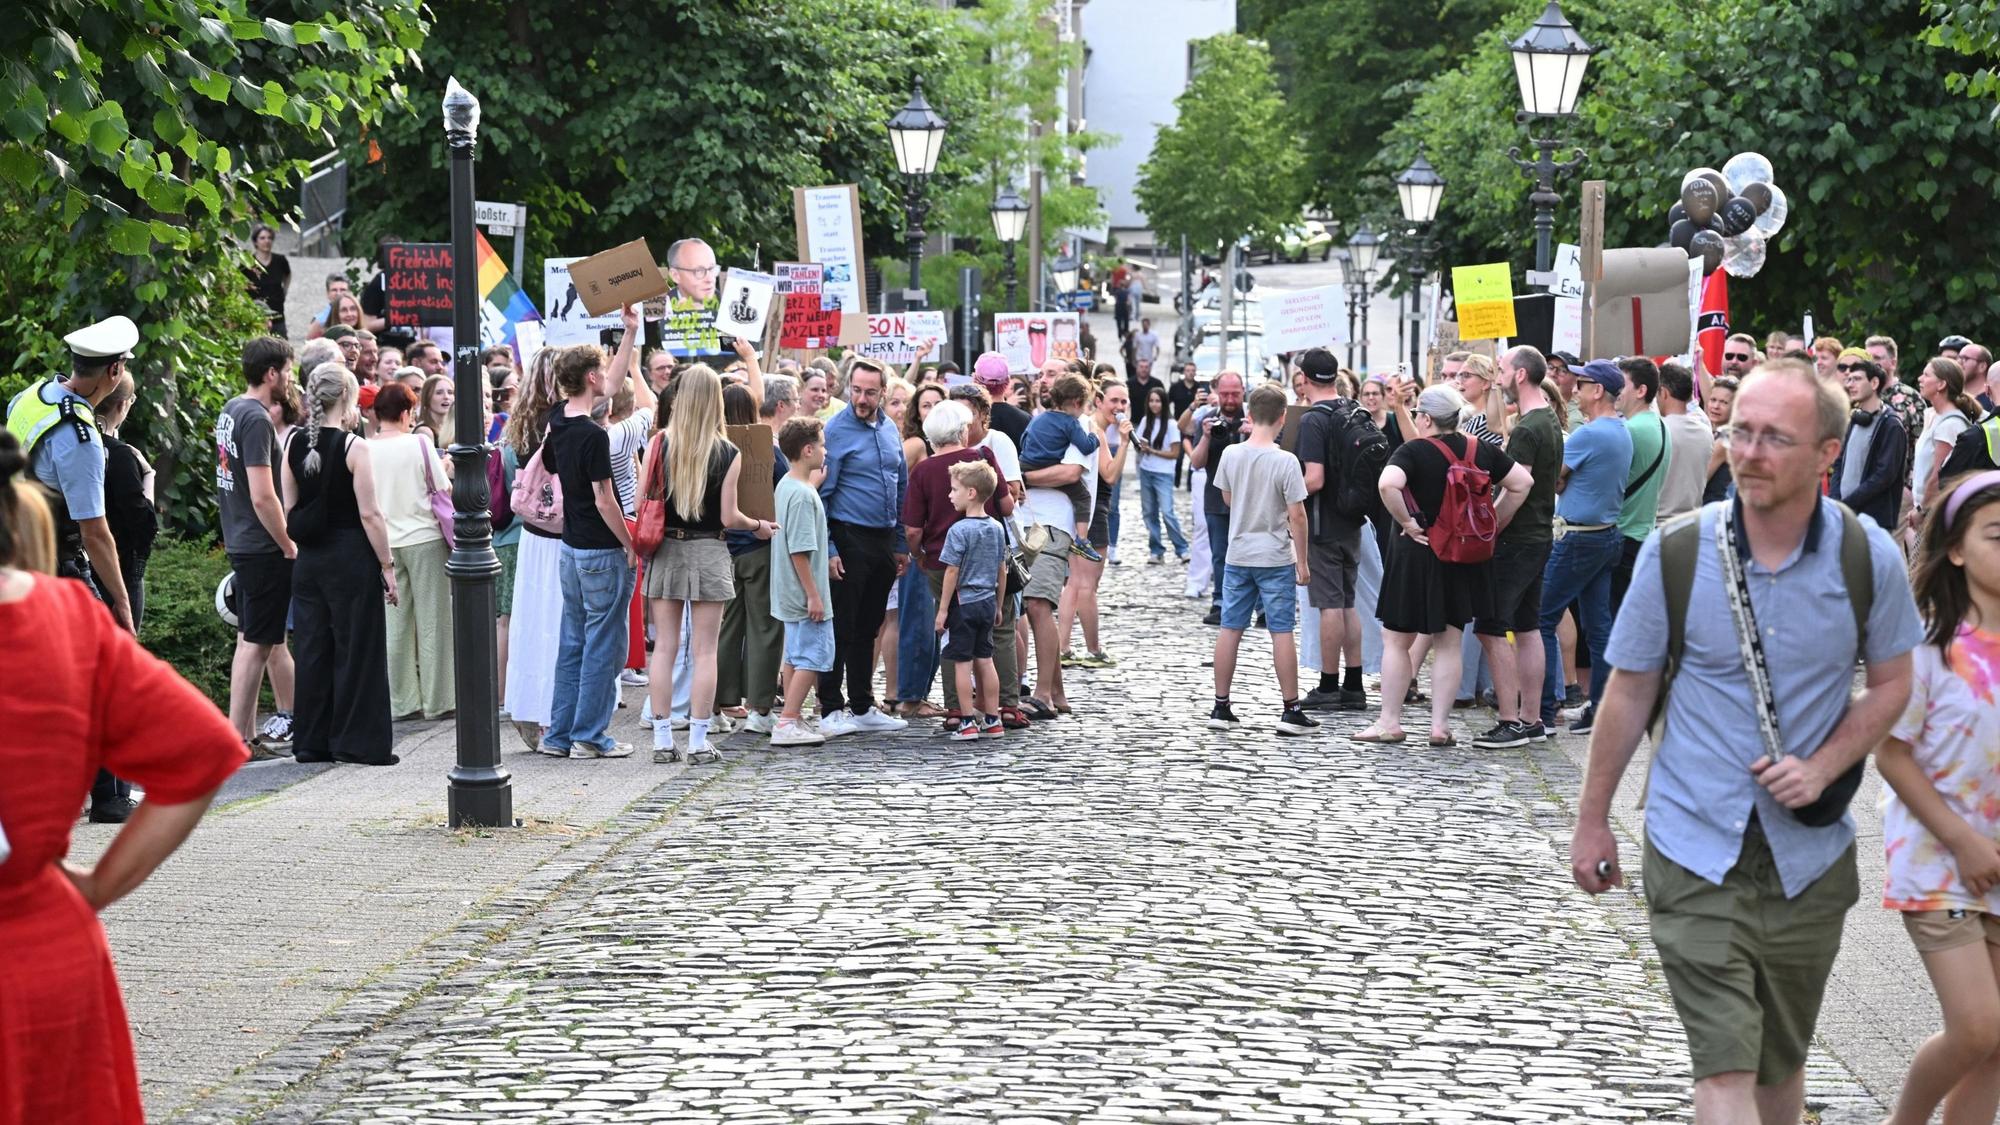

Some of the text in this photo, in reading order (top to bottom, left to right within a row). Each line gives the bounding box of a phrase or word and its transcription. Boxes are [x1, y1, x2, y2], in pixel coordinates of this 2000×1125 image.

[475, 206, 511, 222] loßstr.
[389, 247, 439, 269] Friedrich
[608, 267, 643, 287] hanseatic
[777, 266, 790, 276] IHR
[791, 270, 820, 280] ZAHLEN!
[389, 271, 429, 290] sticht
[777, 280, 793, 292] WIR
[793, 284, 820, 294] LEID!
[389, 293, 453, 310] demokratisch
[786, 297, 804, 309] ERZ
[389, 309, 419, 326] Herz
[784, 310, 833, 323] CHT MEIN
[781, 324, 833, 338] ANZLER
[864, 341, 894, 353] HERR
